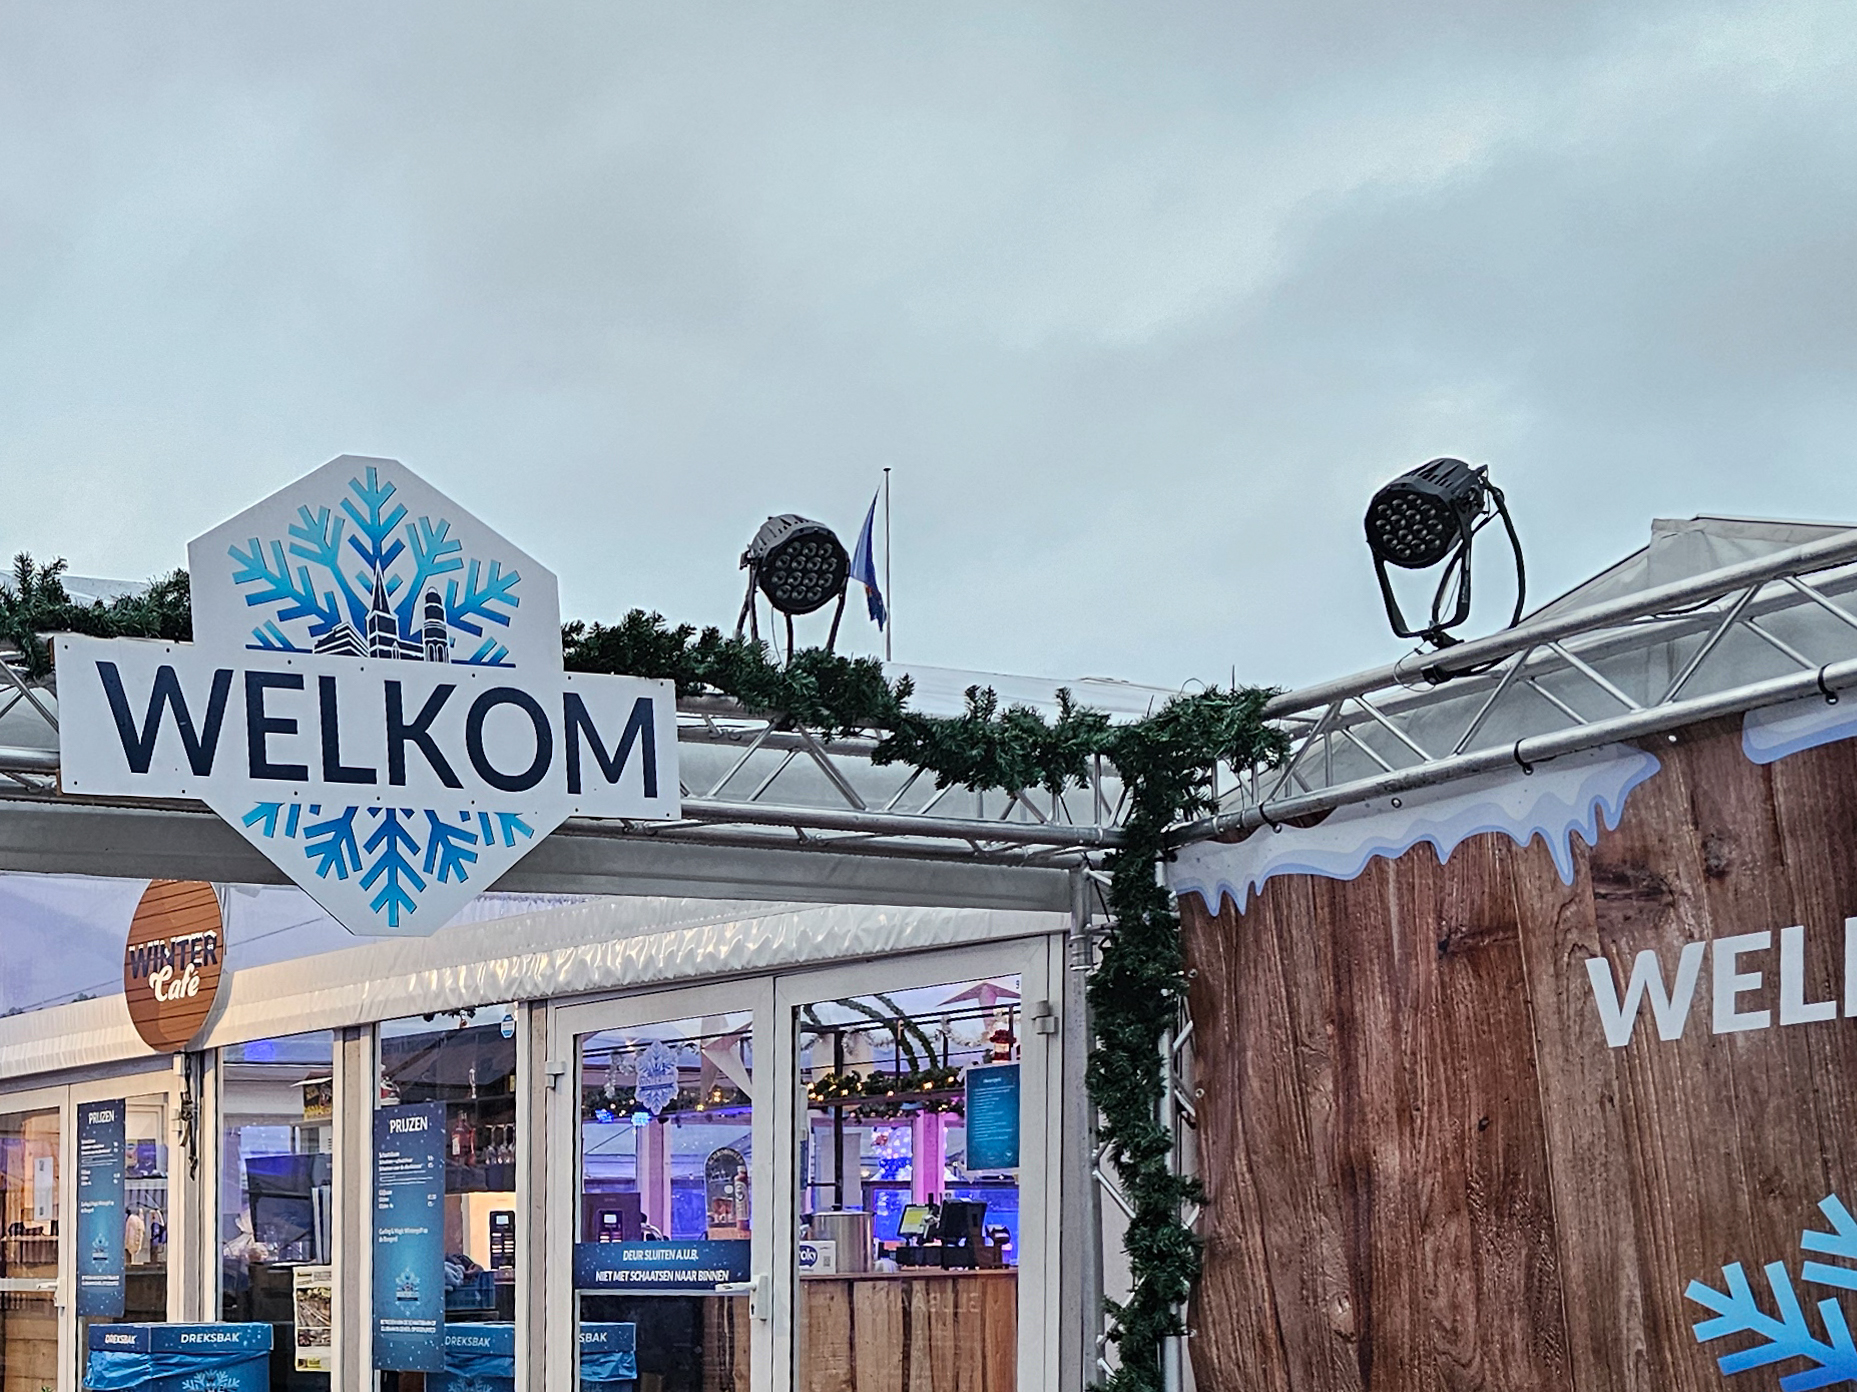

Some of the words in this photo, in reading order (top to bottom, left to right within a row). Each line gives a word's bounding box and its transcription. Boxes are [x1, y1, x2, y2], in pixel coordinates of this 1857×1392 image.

[95, 661, 657, 799] WELKOM
[129, 930, 218, 979] WINTER
[149, 963, 200, 1002] Café
[389, 1116, 428, 1134] PRIJZEN
[622, 1250, 643, 1262] DEUR
[644, 1250, 675, 1261] SLUITEN
[595, 1271, 614, 1282] NIET
[613, 1271, 631, 1282] MET
[630, 1271, 674, 1282] SCHAATSEN
[674, 1271, 698, 1282] NAAR
[697, 1270, 730, 1283] BINNEN
[104, 1334, 138, 1345] DREKSBAK
[180, 1332, 240, 1344] DREKSBAK
[444, 1336, 491, 1348] DREKSBAK
